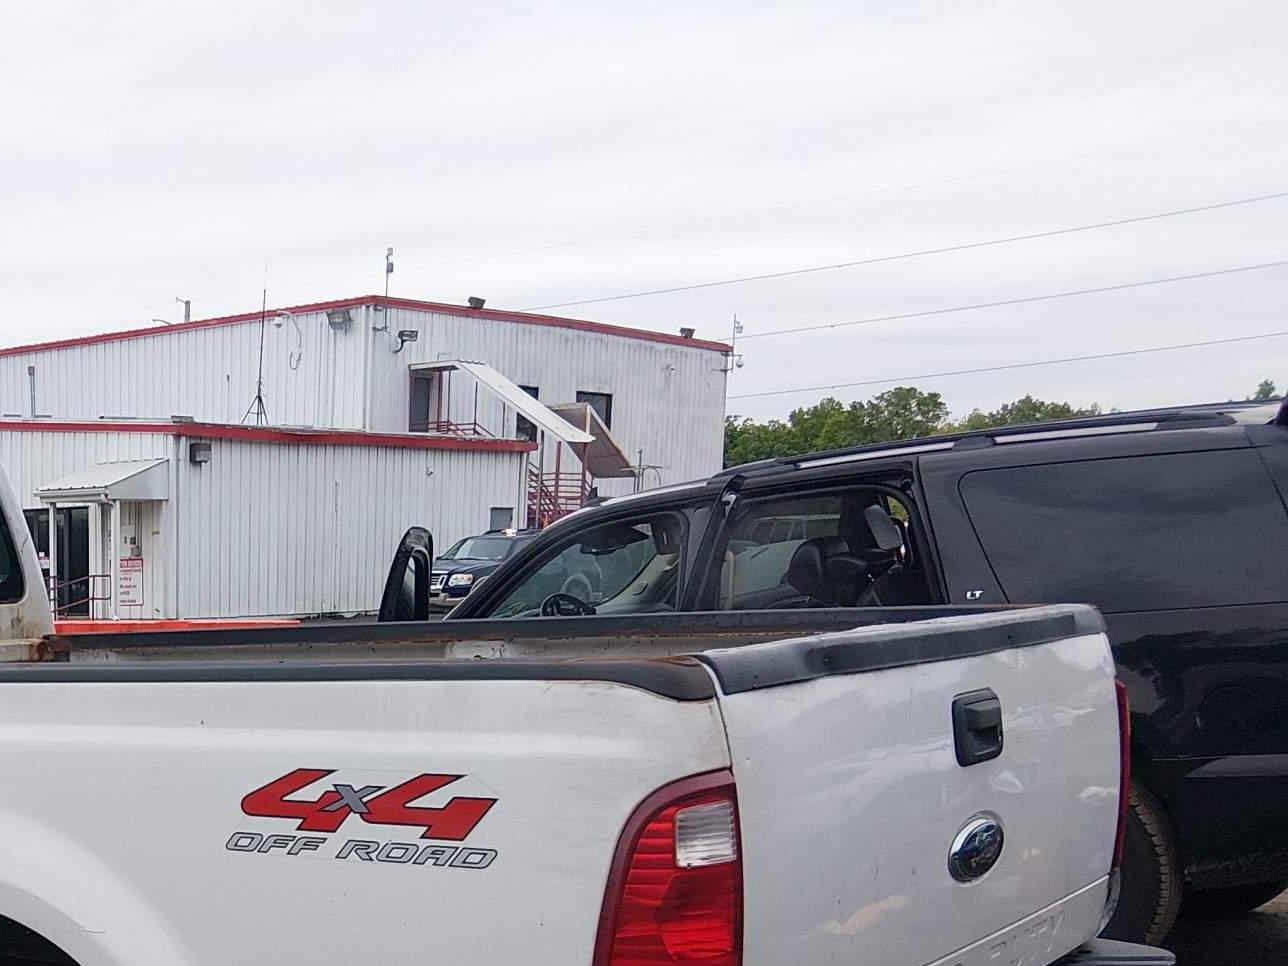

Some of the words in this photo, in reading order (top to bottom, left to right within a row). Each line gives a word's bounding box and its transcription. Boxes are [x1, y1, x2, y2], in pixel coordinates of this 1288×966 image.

[966, 590, 984, 600] LT
[225, 832, 328, 855] OFF
[335, 839, 498, 869] ROAD
